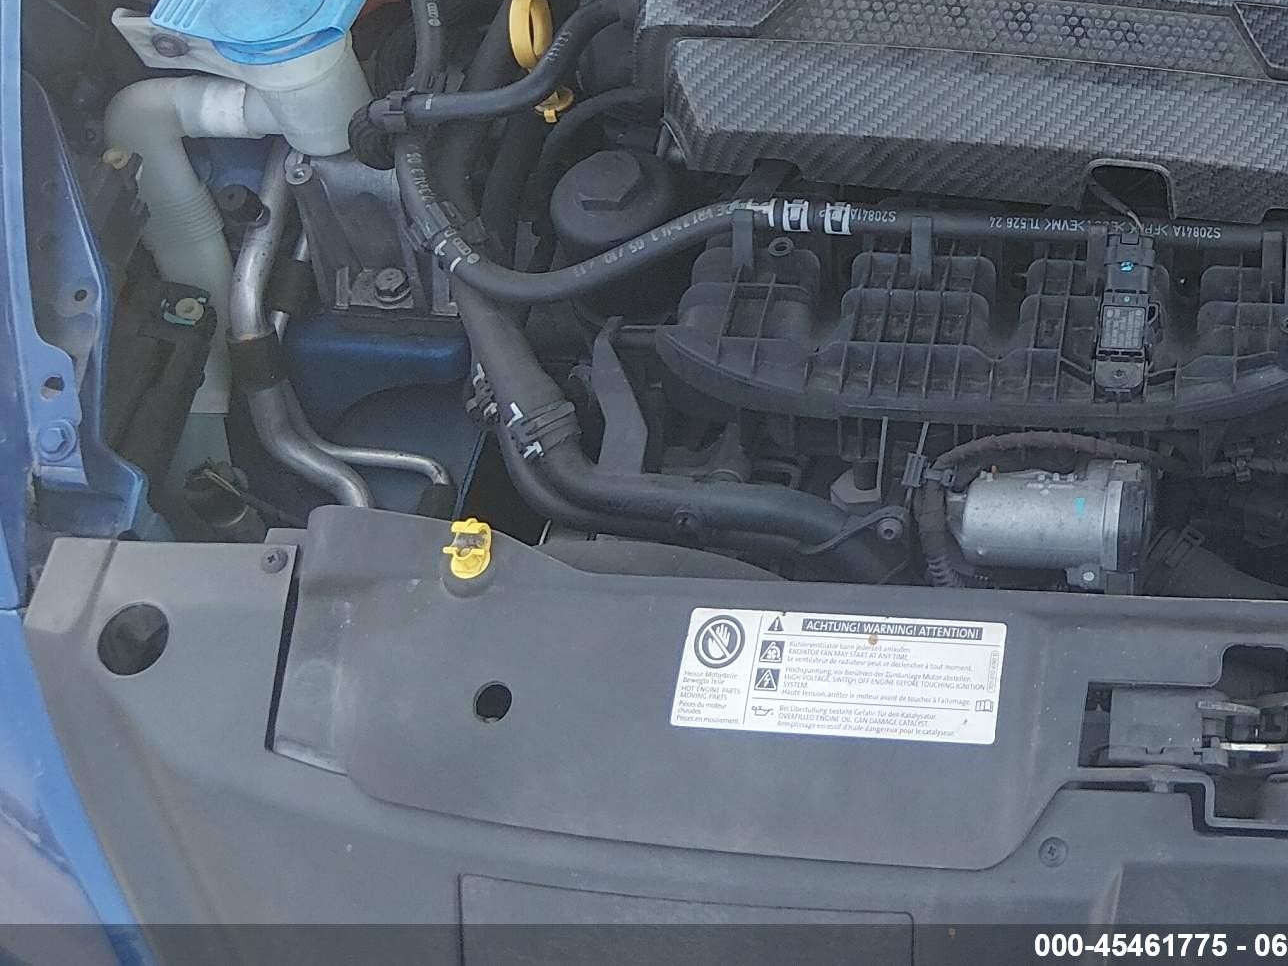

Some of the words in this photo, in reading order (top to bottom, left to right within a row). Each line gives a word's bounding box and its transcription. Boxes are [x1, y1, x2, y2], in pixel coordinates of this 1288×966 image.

[1174, 225, 1222, 239] S20841A
[806, 620, 860, 632] ACHTUNG!
[863, 623, 916, 635] WARNING!
[918, 626, 978, 638] ATTENTION!
